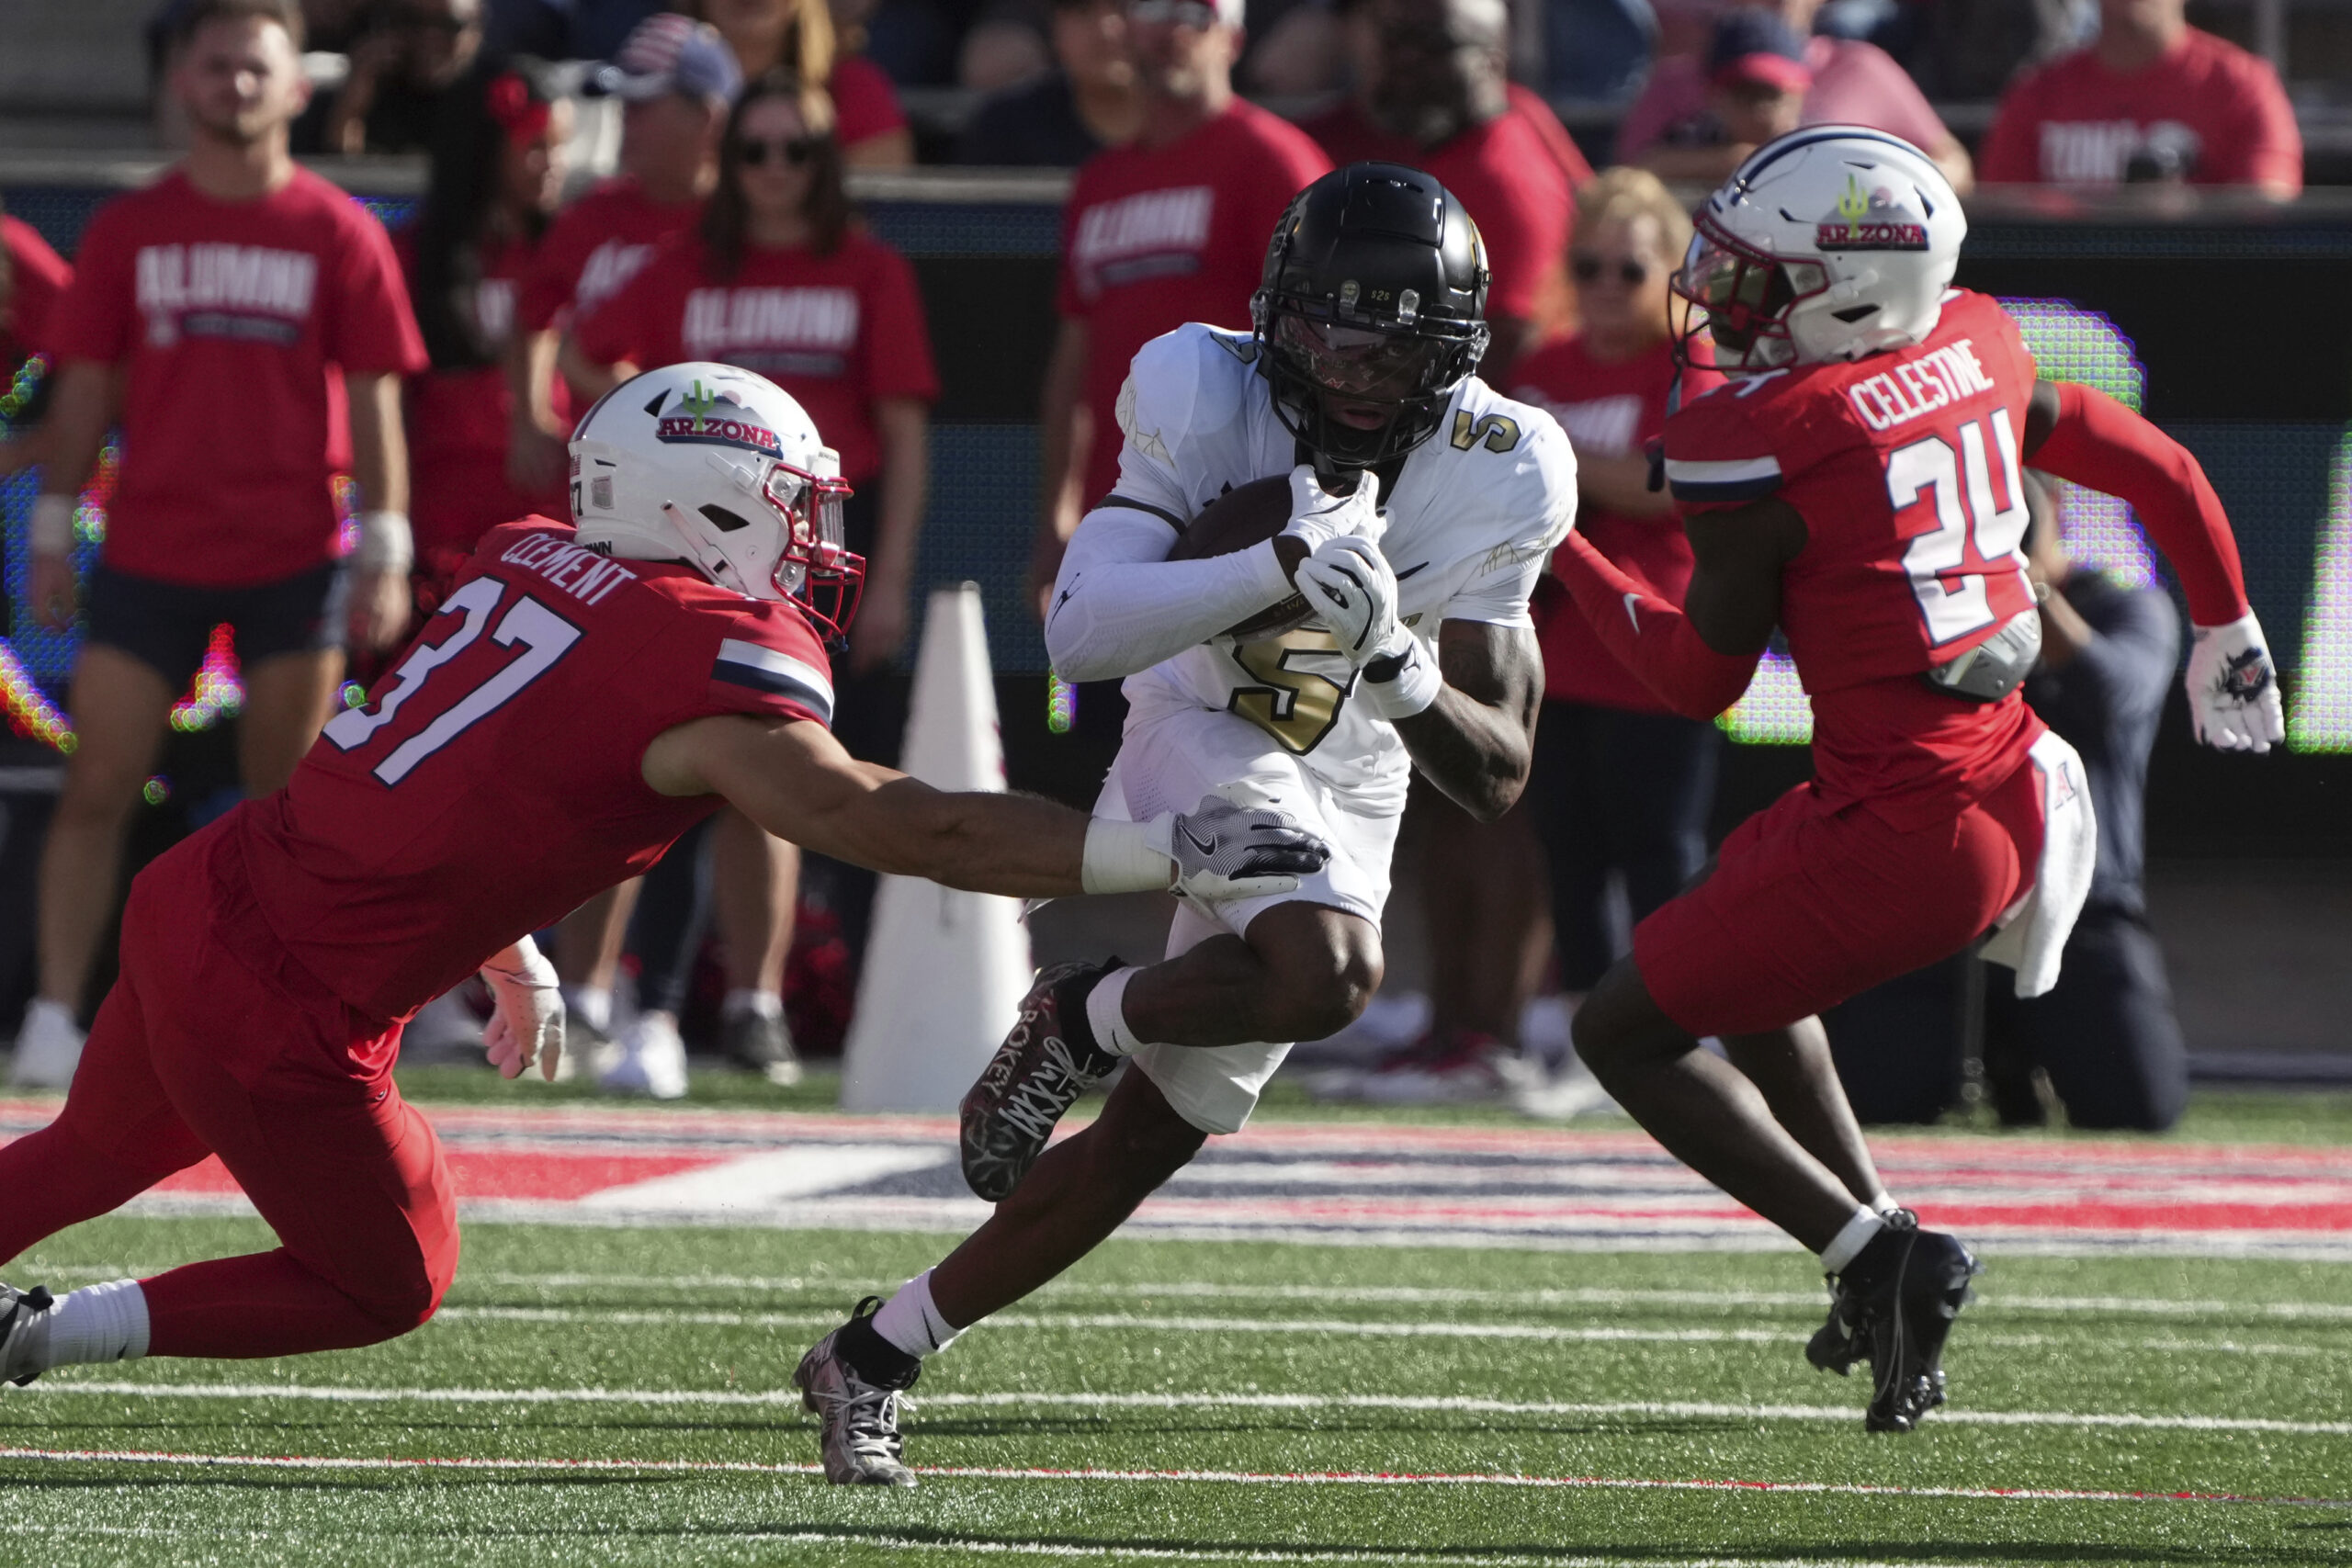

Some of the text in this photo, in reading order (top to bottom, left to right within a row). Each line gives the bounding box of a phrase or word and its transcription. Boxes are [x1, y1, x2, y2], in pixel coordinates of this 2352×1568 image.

[1816, 223, 1926, 245] ARIZONA
[1849, 339, 1995, 431] CELESTINE
[656, 416, 779, 451] ARIZONA
[501, 533, 638, 606] CLEMENT
[1886, 407, 2040, 647] 24
[322, 573, 588, 792] 37
[1227, 626, 1361, 756] 5
